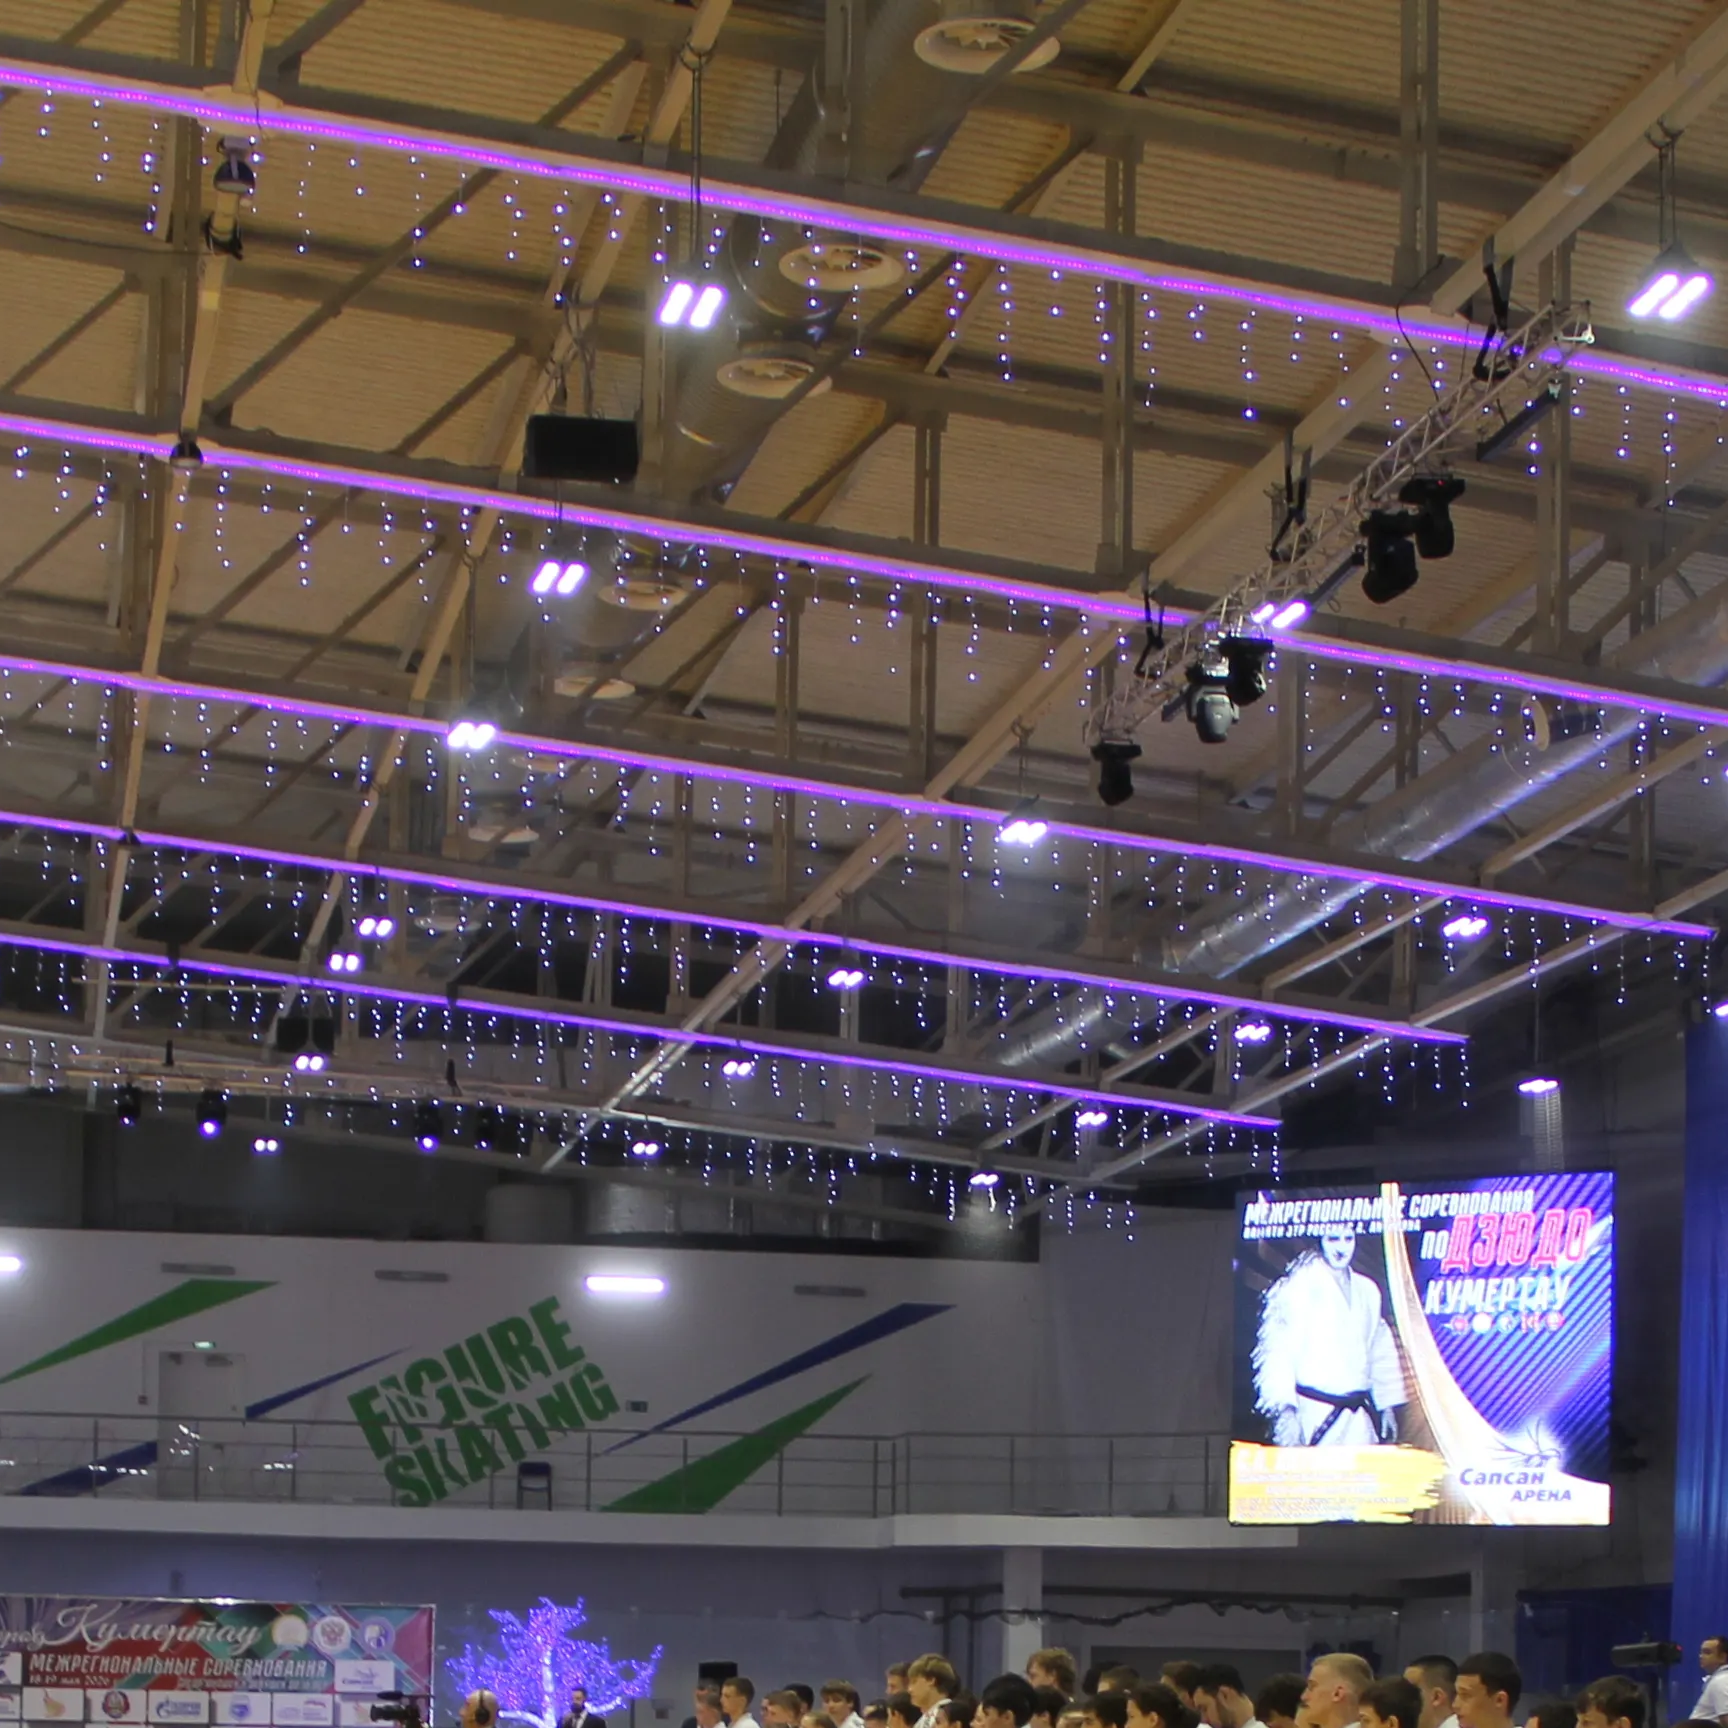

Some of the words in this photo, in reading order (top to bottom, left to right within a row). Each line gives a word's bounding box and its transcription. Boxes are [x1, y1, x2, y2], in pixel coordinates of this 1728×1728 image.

[1409, 1189, 1534, 1218] СОРЕВНОВАНИЯ
[1420, 1230, 1450, 1259] ПО
[1441, 1208, 1592, 1274] ДЗЮДО
[1425, 1276, 1572, 1315] КУМЕРТАУ
[347, 1296, 586, 1460] FIGURE
[384, 1362, 620, 1508] SKATING
[1459, 1469, 1544, 1485] Сапсан
[1511, 1488, 1572, 1502] АРЕНА
[29, 1653, 198, 1676] МЕЖРЕГИОНАЛЬНЫЕ
[203, 1657, 327, 1677] СОРЕВНОВАНИЯ
